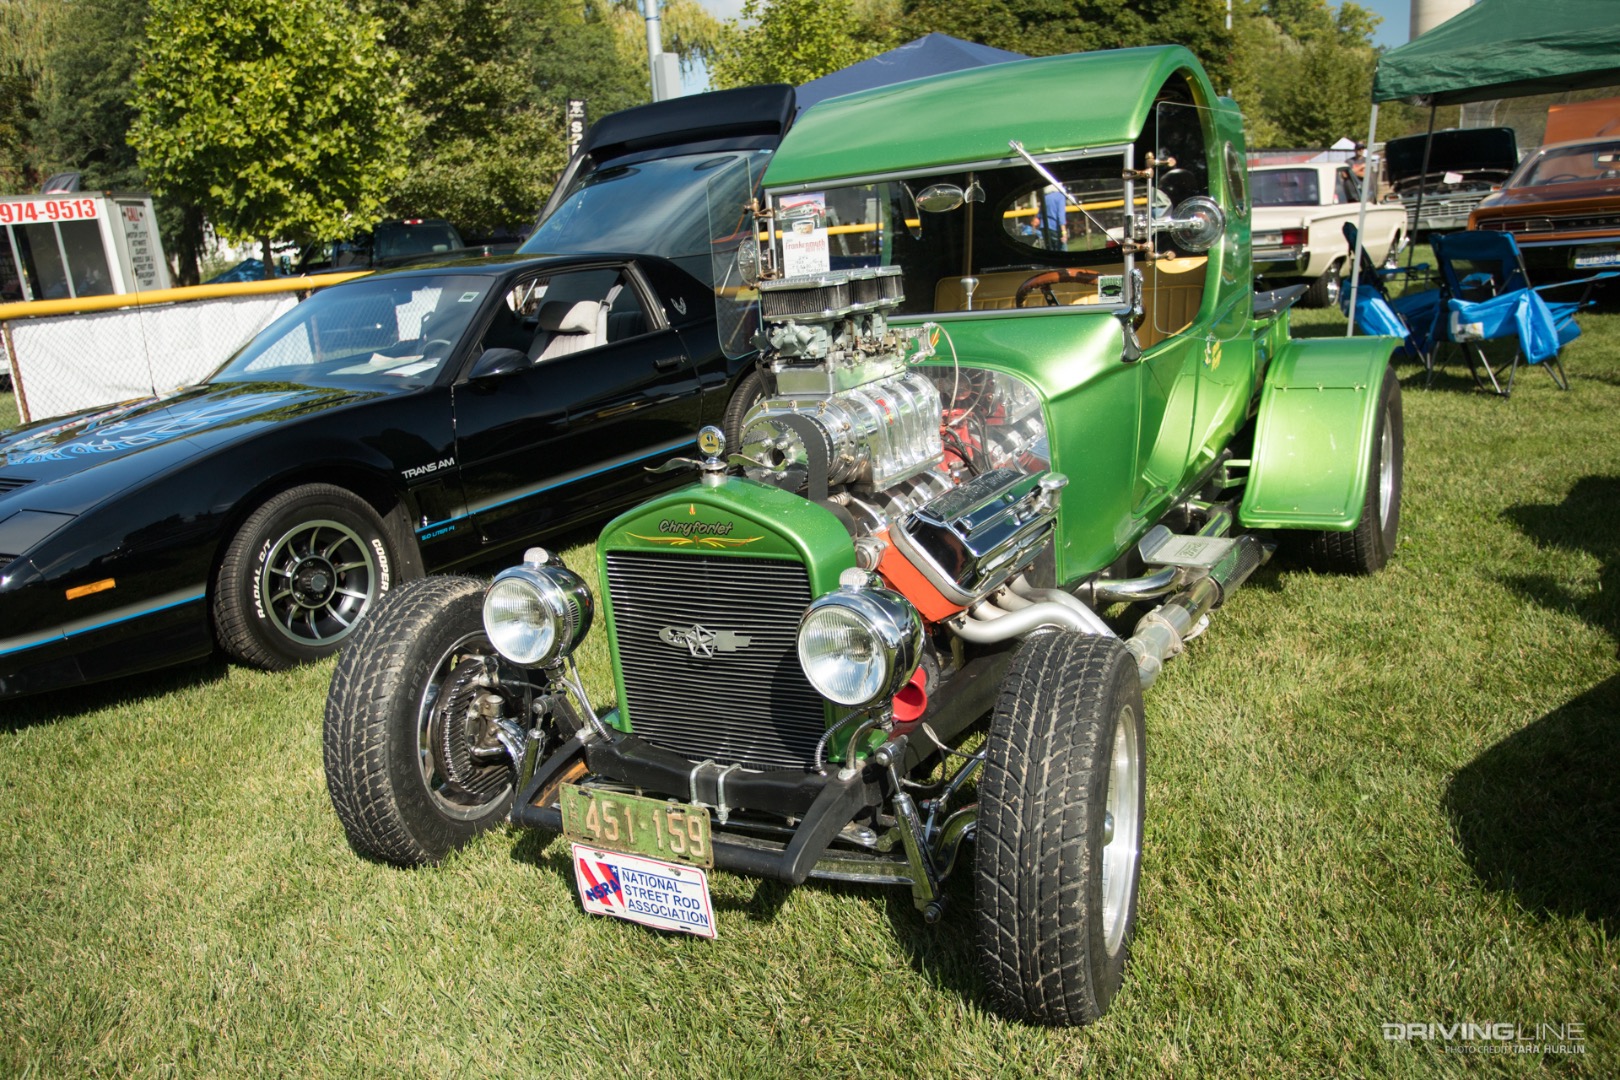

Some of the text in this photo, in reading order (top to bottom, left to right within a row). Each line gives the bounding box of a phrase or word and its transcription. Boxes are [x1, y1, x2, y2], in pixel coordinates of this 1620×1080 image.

[0, 199, 96, 223] 974-9513
[401, 457, 455, 479] TRANS AM
[432, 528, 448, 537] LITER
[371, 538, 390, 591] COOPER
[253, 566, 266, 619] RADIAL
[585, 879, 621, 902] NSRA
[622, 871, 682, 893] NATIONAL
[624, 885, 700, 910] STREET ROD
[628, 899, 708, 925] ASSOCIATION
